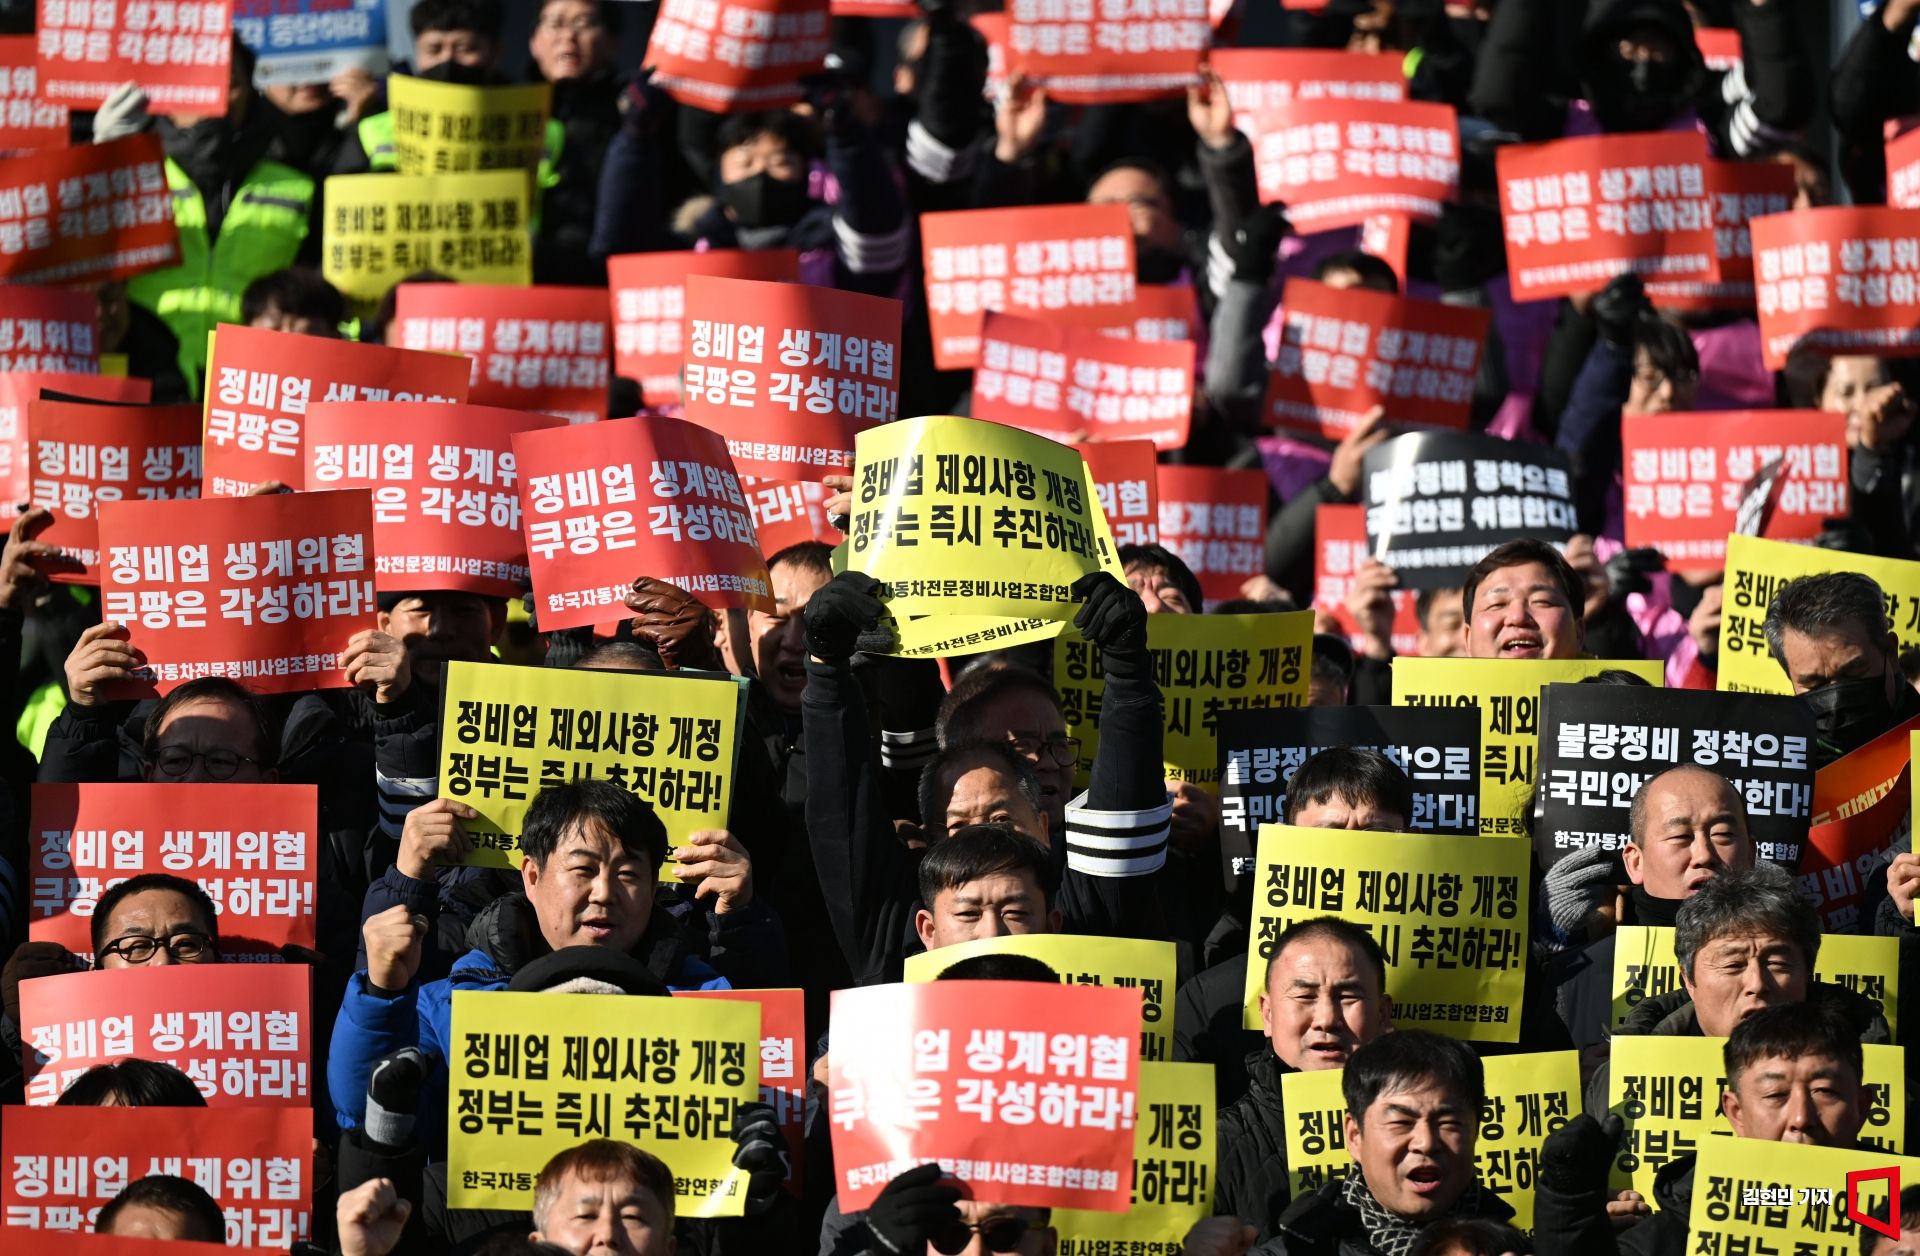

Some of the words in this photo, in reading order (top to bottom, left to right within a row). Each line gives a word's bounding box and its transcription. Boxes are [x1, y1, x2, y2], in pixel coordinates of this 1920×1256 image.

[0, 184, 49, 220] 비업
[1507, 171, 1591, 211] 정비업
[1600, 164, 1704, 200] 생계위협
[0, 218, 50, 255] 팡은
[1507, 207, 1590, 246] 쿠팡은
[1597, 198, 1713, 235] 각성하라!
[1760, 241, 1830, 281] 정비업
[1840, 238, 1920, 272] 생계위
[692, 320, 765, 363] 정비업
[778, 328, 894, 380] 생계위협
[218, 367, 311, 414] 정비업
[686, 364, 756, 407] 쿠팡은
[769, 373, 897, 422] 각성하라!
[208, 408, 300, 456] 쿠팡은
[38, 440, 128, 481] 정비업
[314, 444, 413, 481] 정비업
[1474, 460, 1570, 497] 정착으로
[1632, 449, 1716, 481] 정비업
[529, 464, 637, 515] 정비업
[649, 461, 744, 507] 생계위협
[861, 454, 924, 503] 정비업
[935, 454, 1036, 500] 제외사항
[1042, 468, 1083, 516] 개정
[1628, 484, 1713, 520] 쿠팡은
[530, 510, 637, 560] 쿠팡은
[648, 505, 760, 548] 각성하라!
[854, 505, 919, 552] 정부는
[930, 505, 981, 546] 즉시
[993, 505, 1096, 560] 추진하라!
[110, 544, 209, 584] 정비업
[224, 533, 365, 581] 생계위협
[106, 589, 207, 628] 쿠팡은
[220, 579, 374, 626] 각성하라!
[1153, 648, 1250, 688] 제외사항
[1257, 647, 1302, 683] 개정
[457, 701, 537, 748] 정비업
[548, 708, 658, 757] 제외사항
[668, 716, 721, 761] 개정
[1558, 722, 1679, 763] 불량정비
[1692, 729, 1808, 770] 정착으로
[448, 753, 528, 799] 정부는
[1484, 745, 1533, 785] 즉시
[41, 831, 143, 869] 정비업
[160, 831, 304, 870] 생계위협
[197, 878, 312, 917] 성하라!
[1266, 864, 1344, 911] 정비업
[1356, 871, 1462, 918] 제외사항
[1470, 875, 1518, 919] 개정
[1410, 925, 1520, 971] 추진하라!
[31, 1016, 133, 1064] 정비업
[150, 1011, 298, 1051] 생계위협
[464, 1033, 548, 1080] 정비업
[563, 1035, 679, 1083] 제외사항
[691, 1040, 745, 1086] 개정
[965, 1030, 1128, 1080] 생계위협
[457, 1089, 544, 1135] 정부는
[556, 1092, 612, 1138] 즉시
[955, 1079, 1134, 1130] 각성하라!
[1518, 1092, 1569, 1136] 개정
[1623, 1076, 1702, 1119] 정비업
[1148, 1104, 1202, 1150] 개정
[13, 1156, 128, 1197] 정비업
